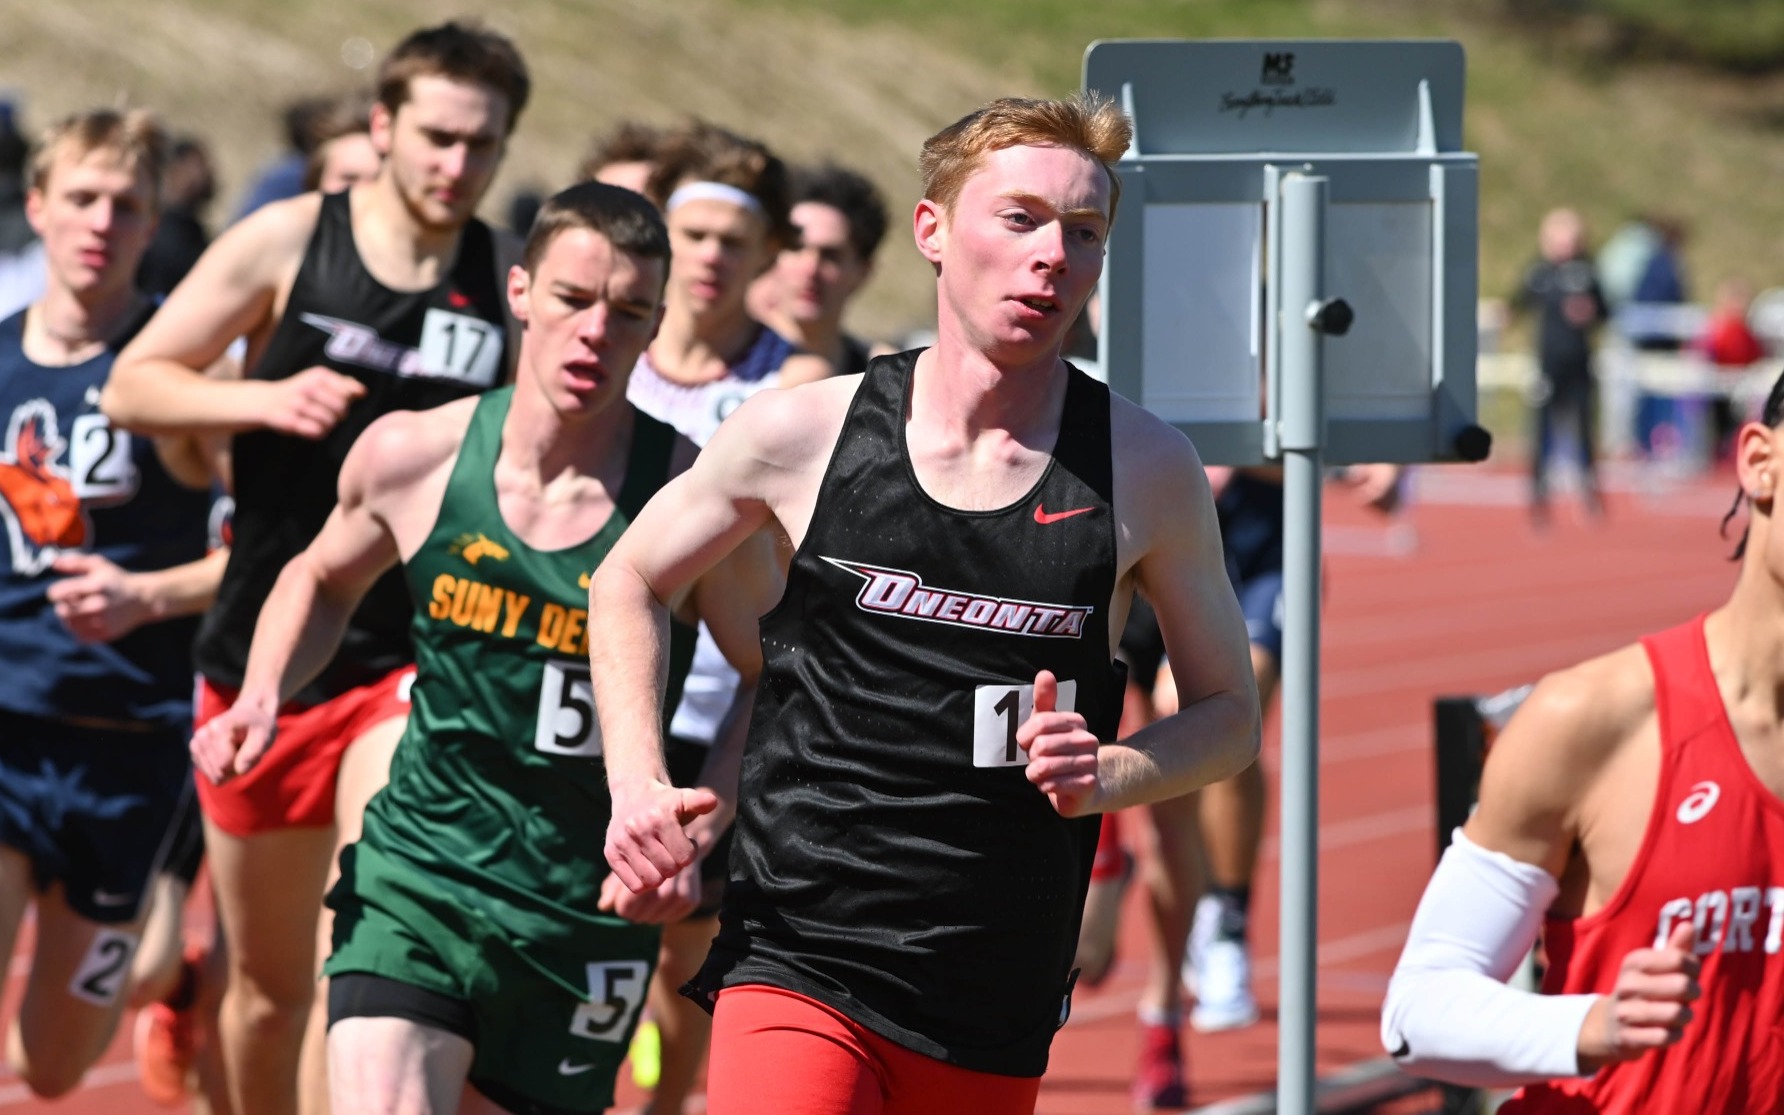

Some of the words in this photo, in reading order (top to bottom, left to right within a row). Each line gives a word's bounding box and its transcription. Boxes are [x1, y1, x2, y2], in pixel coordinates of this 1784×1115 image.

[443, 322, 488, 374] 17
[84, 425, 119, 485] 2
[428, 573, 531, 639] SUNY
[535, 602, 590, 655] DE
[554, 667, 593, 749] 5
[993, 689, 1034, 763] 1
[81, 940, 128, 997] 2
[585, 967, 635, 1035] 5
